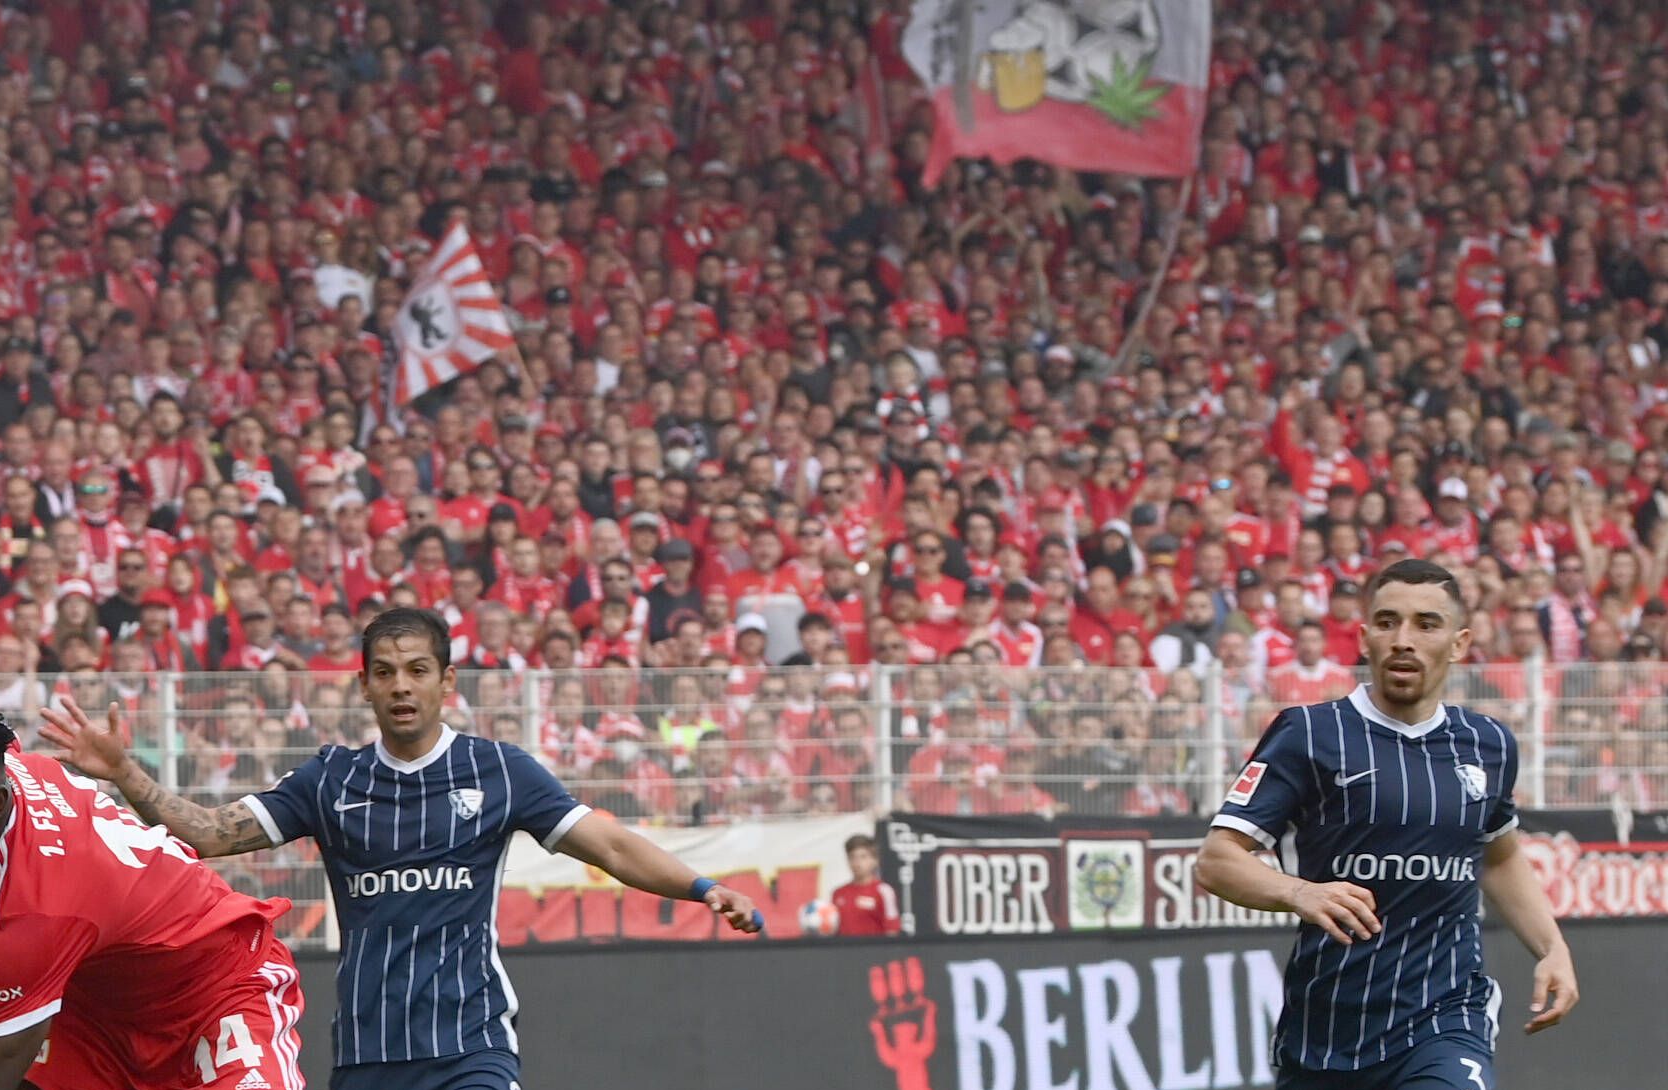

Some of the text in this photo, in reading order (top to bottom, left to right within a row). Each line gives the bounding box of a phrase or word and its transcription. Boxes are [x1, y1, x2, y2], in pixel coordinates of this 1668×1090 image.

[27, 806, 61, 832] FC
[346, 867, 474, 898] VONOVIA
[1332, 853, 1477, 882] VONOVIA
[935, 852, 1055, 935] OBER
[194, 1013, 264, 1085] 14
